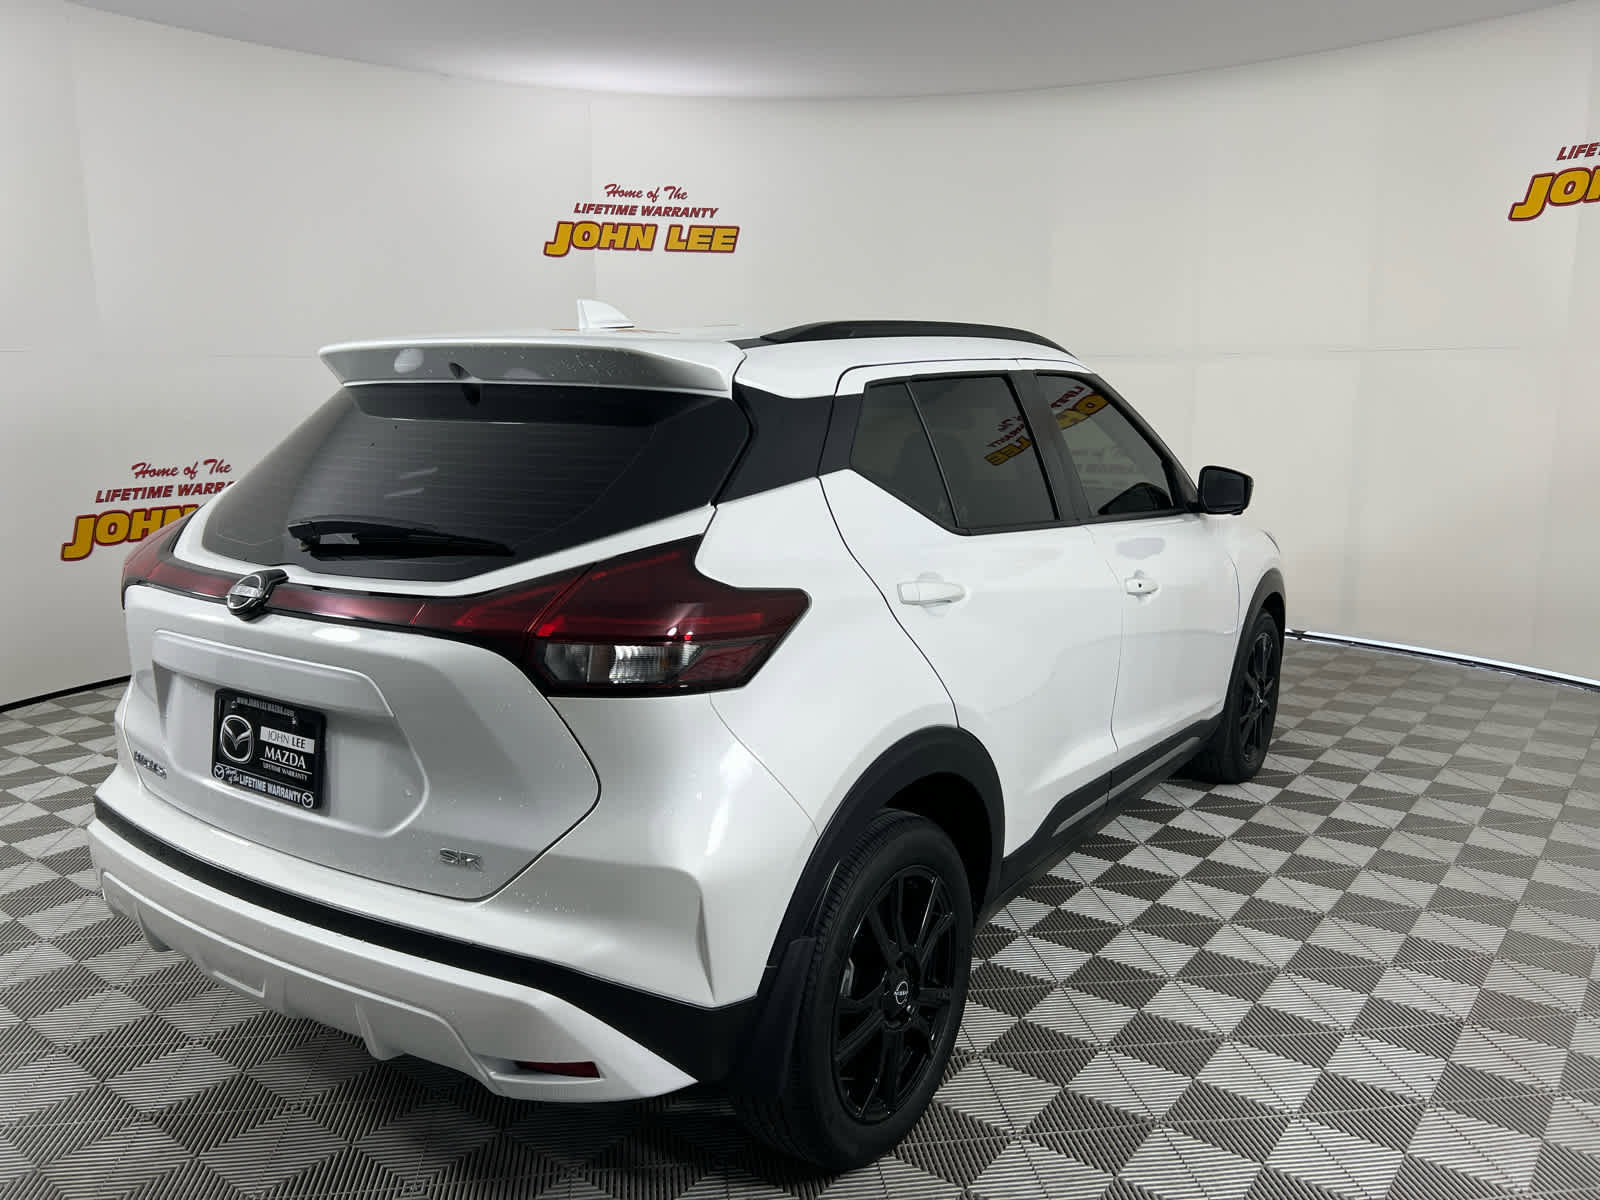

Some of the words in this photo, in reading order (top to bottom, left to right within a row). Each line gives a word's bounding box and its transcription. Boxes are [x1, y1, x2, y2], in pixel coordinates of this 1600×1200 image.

[604, 184, 643, 199] Home
[646, 187, 660, 203] of
[663, 186, 688, 200] The
[574, 202, 638, 217] LIFETIME
[641, 205, 719, 219] WARRANTY
[543, 221, 658, 258] JOHN
[664, 224, 740, 254] LEE
[131, 461, 179, 479] Home
[183, 461, 198, 480] of
[203, 459, 232, 476] The
[95, 485, 174, 503] LIFETIME
[267, 729, 290, 745] JOHN
[292, 737, 306, 749] LEE
[264, 745, 306, 769] MAZDA
[240, 774, 266, 791] LIFETIME
[268, 783, 300, 802] WARRANTY
